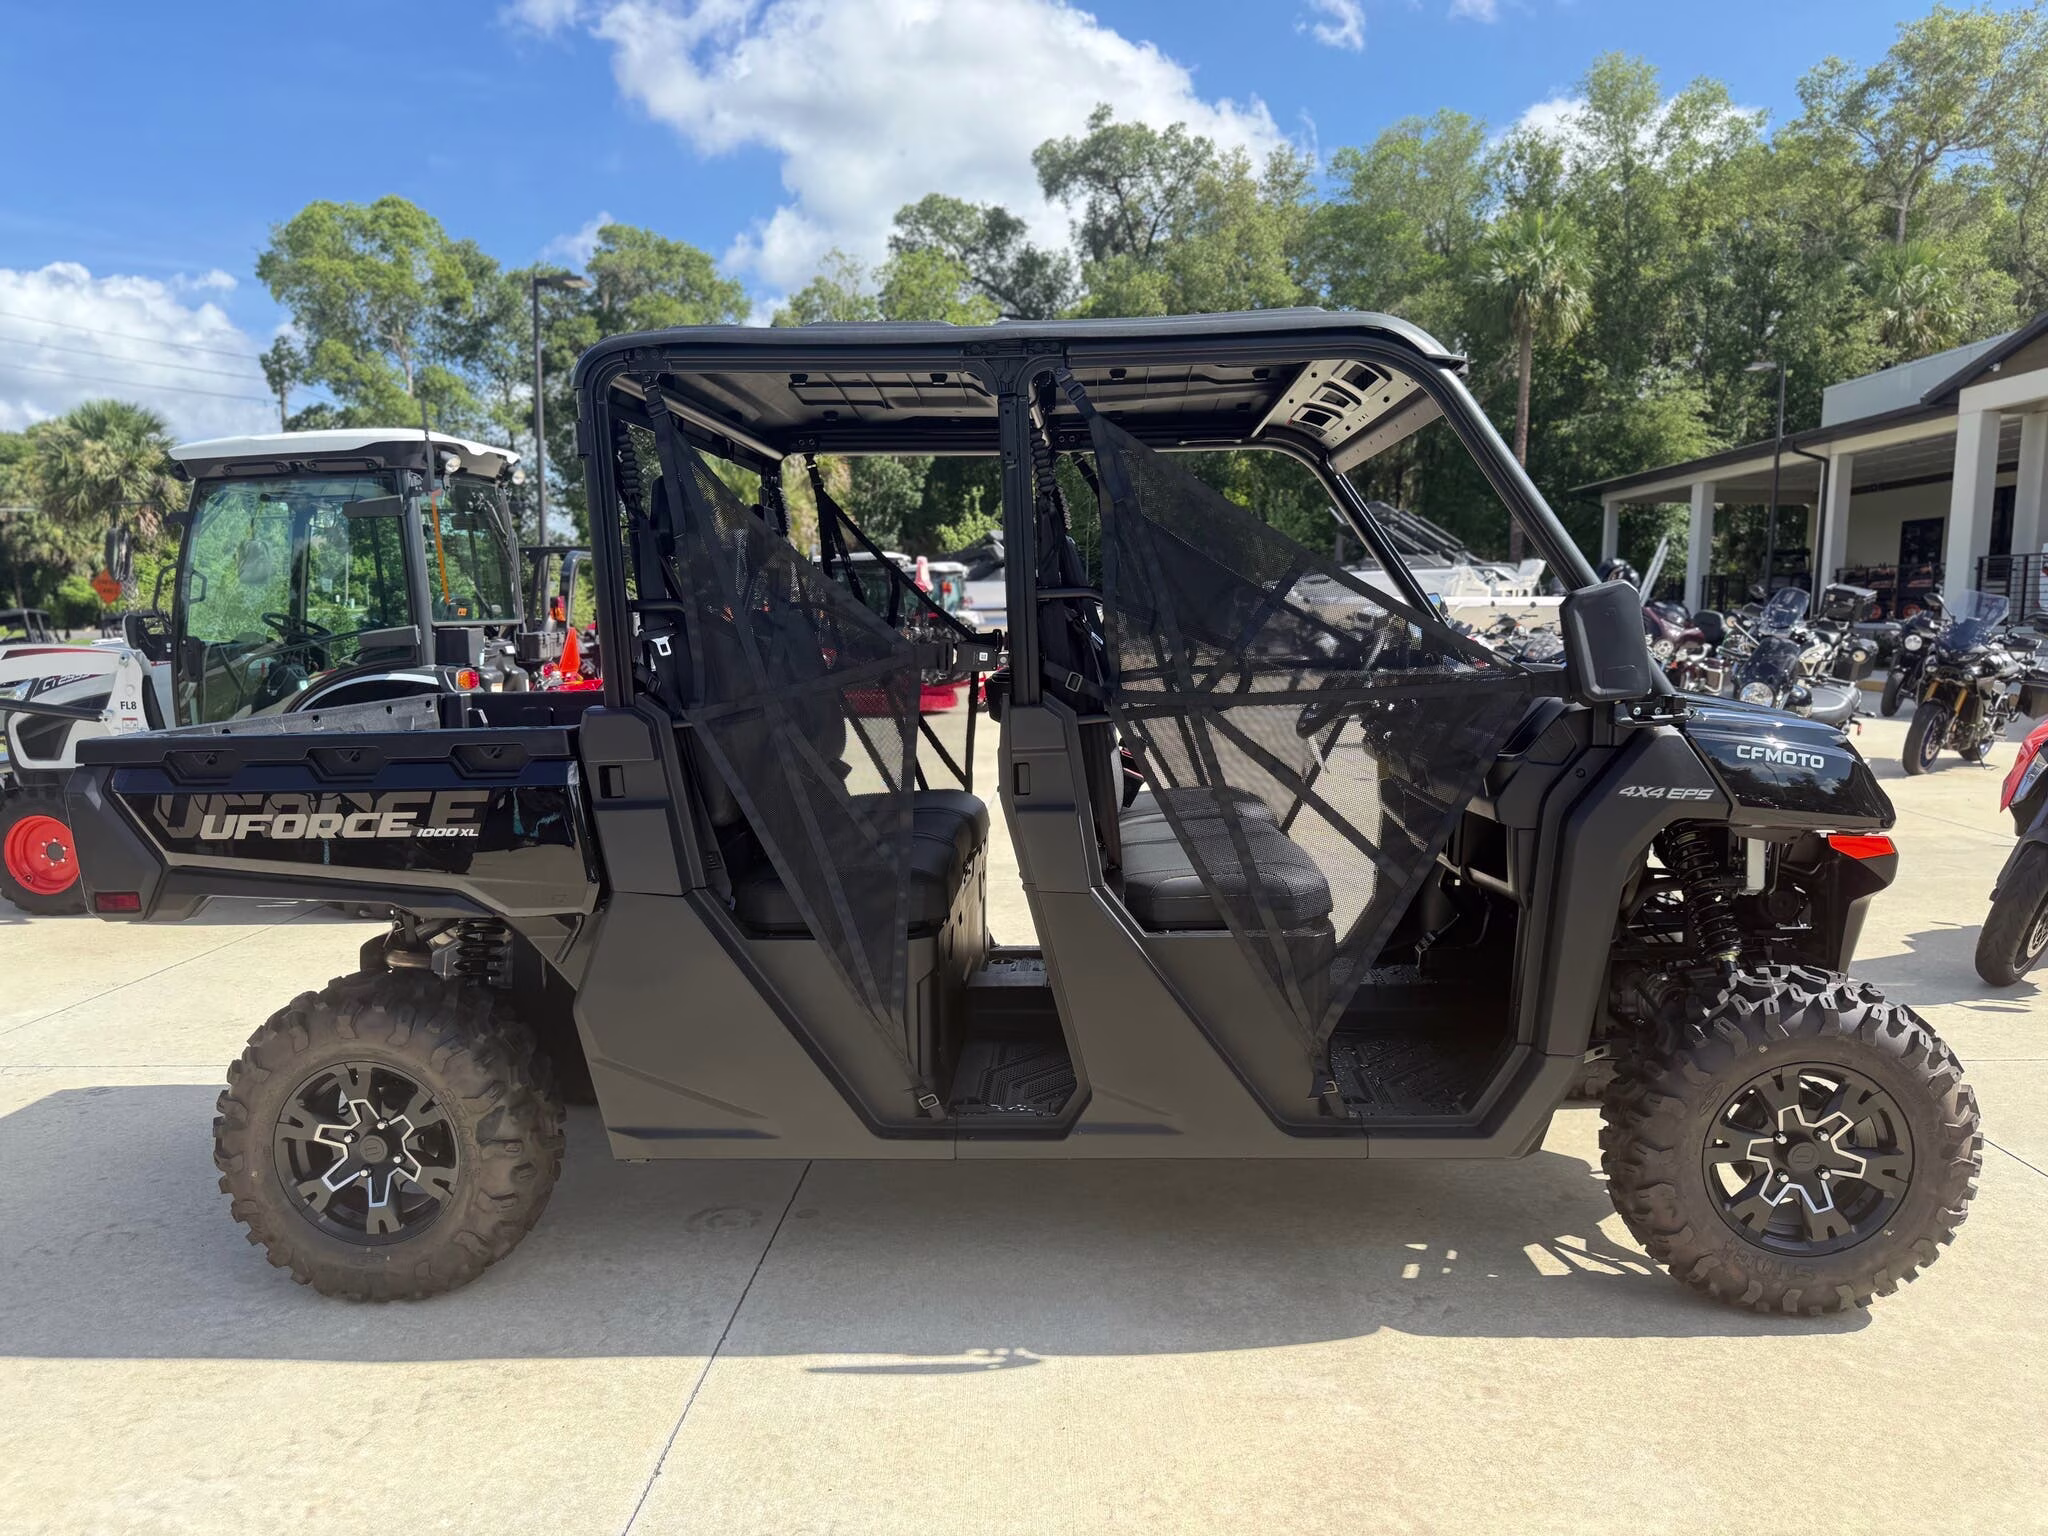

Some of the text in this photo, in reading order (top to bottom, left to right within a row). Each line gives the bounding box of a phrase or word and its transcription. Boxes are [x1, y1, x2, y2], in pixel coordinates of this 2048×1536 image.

[120, 701, 137, 710] FL8
[1736, 745, 1825, 769] CFMOTO
[1619, 786, 1715, 800] 4X4 EPS
[200, 812, 479, 840] UFORCE 1000 XL
